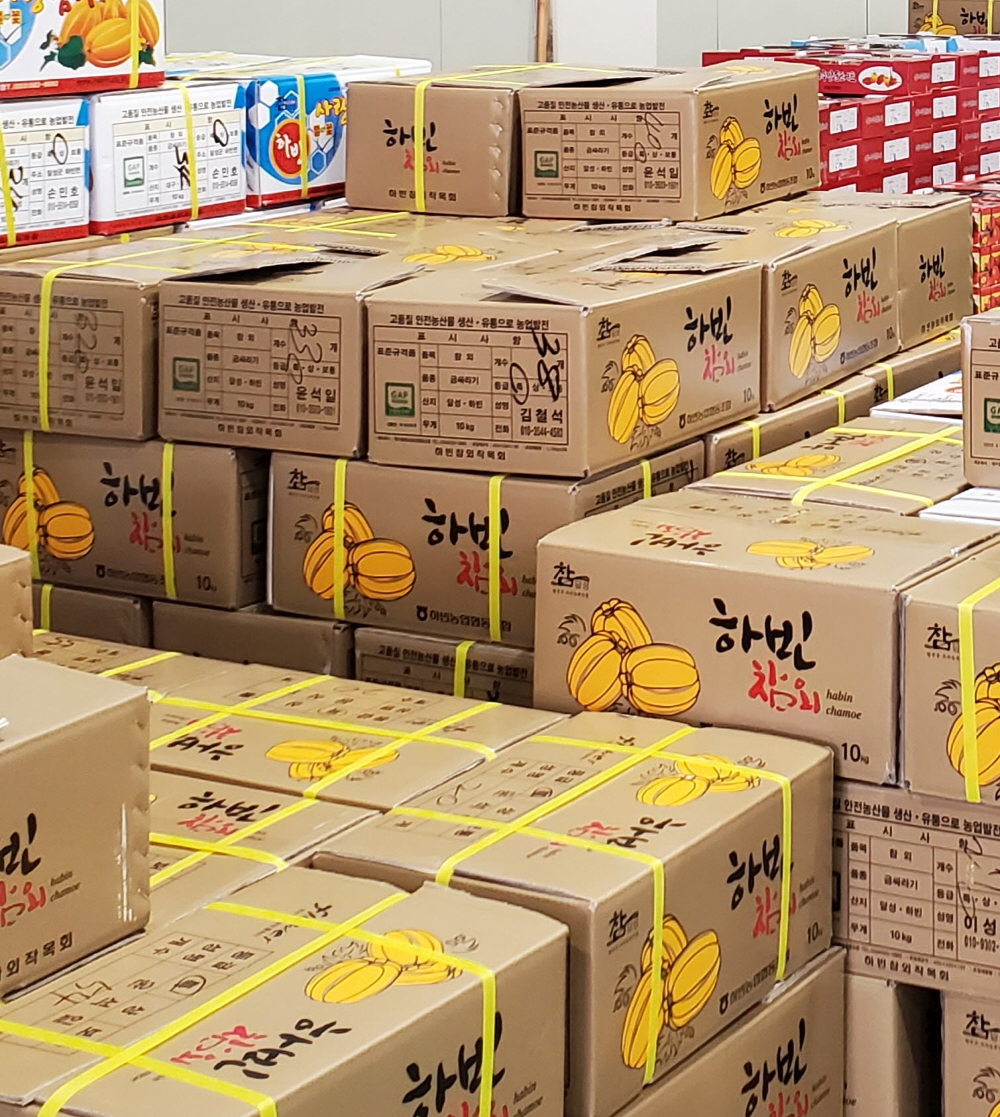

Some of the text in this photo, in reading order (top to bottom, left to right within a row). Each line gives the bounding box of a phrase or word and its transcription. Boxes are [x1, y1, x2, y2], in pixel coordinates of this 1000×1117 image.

[763, 93, 798, 134] 하빈
[842, 247, 878, 298] 하빈
[919, 247, 945, 283] 하빈
[684, 296, 733, 352] 하빈
[709, 598, 816, 671] 하빈
[826, 689, 853, 703] habin
[826, 705, 862, 720] chamoe
[844, 799, 890, 818] 안전농산물
[893, 808, 912, 821] 생산
[921, 813, 960, 829] 유통으로
[741, 1018, 807, 1117] 하빈
